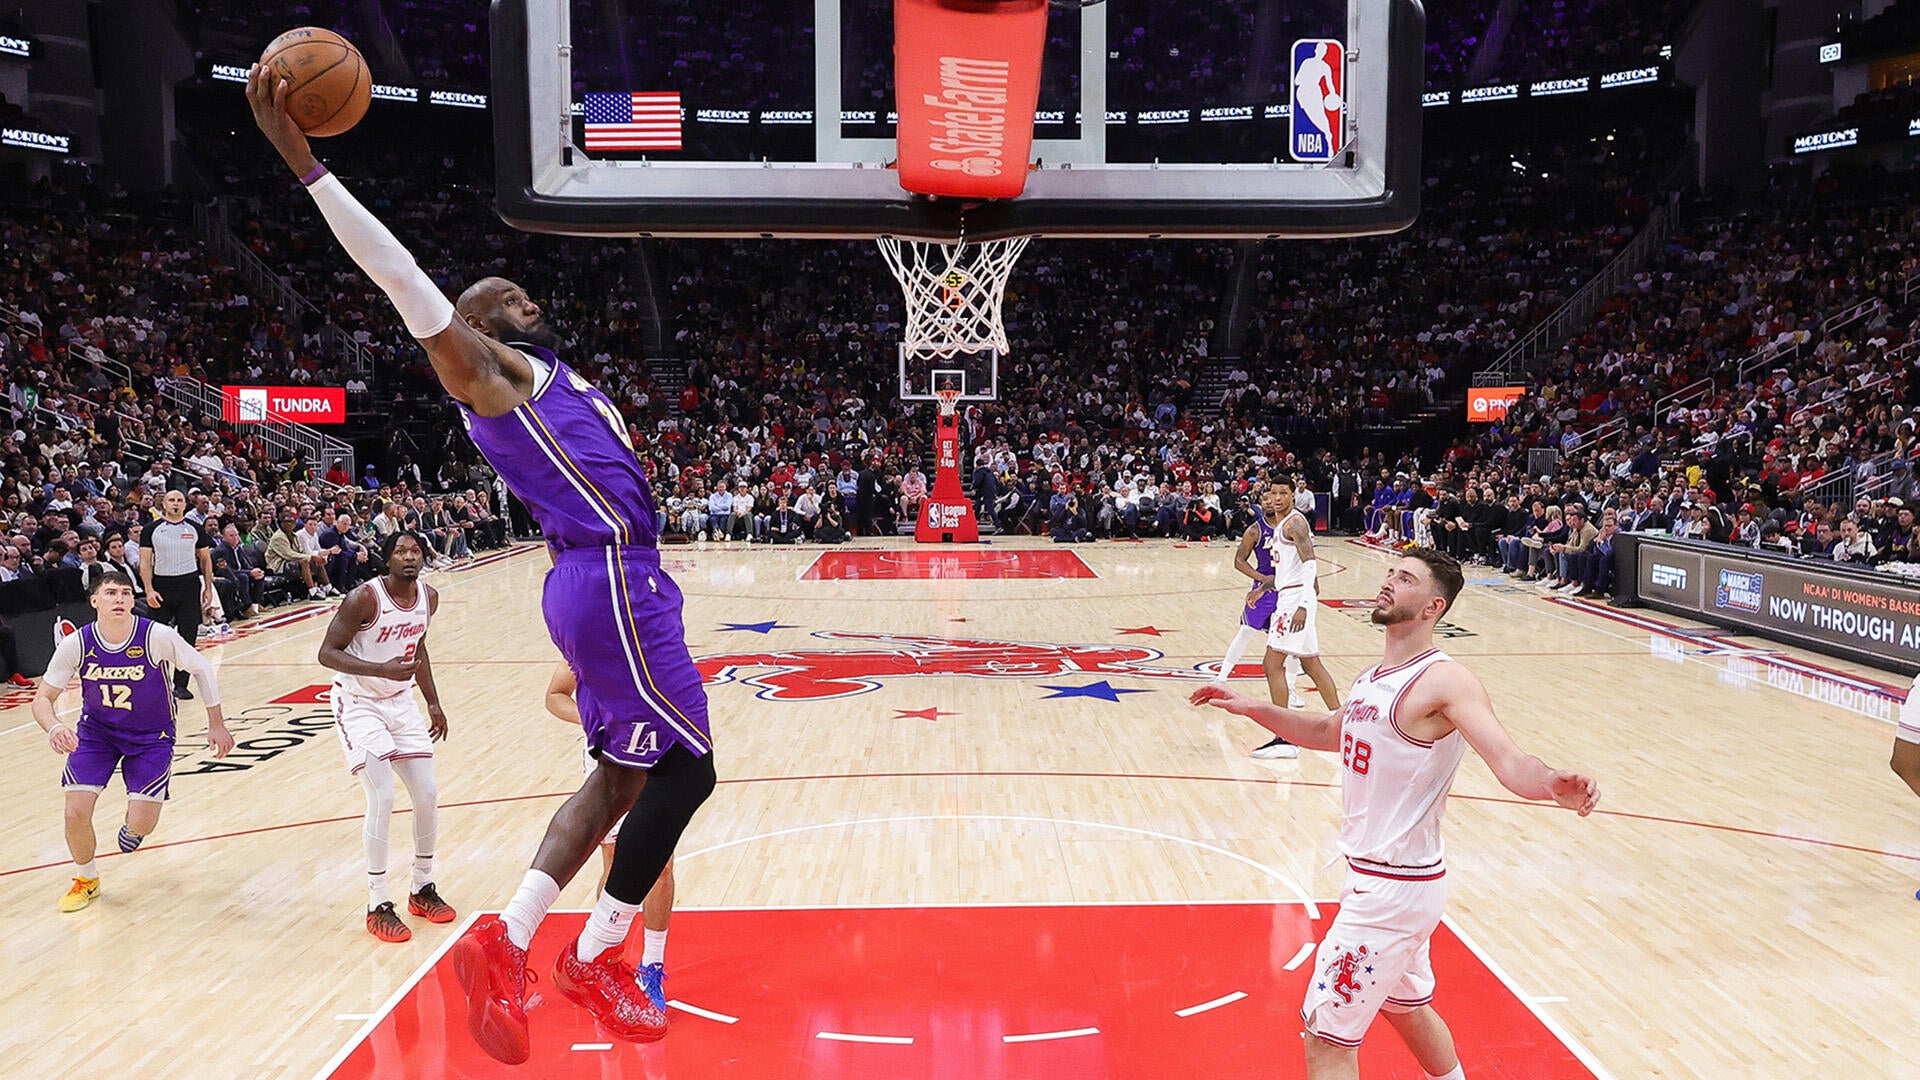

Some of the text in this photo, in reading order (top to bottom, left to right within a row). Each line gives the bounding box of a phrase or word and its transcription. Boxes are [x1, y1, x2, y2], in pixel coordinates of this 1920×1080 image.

[0, 36, 30, 51] ON'S
[1601, 66, 1658, 84] MORTON'S
[371, 84, 418, 98] ORTON'S
[1461, 84, 1519, 99] MORTON'S
[1530, 77, 1590, 92] MORTON'S
[429, 90, 487, 105] MORTON'S
[1422, 91, 1450, 102] ON'S
[696, 109, 750, 119] MORTON'S
[759, 110, 813, 120] MORTON'S
[840, 111, 876, 120] RTON'S
[1034, 111, 1064, 120] TON'S
[1138, 109, 1191, 120] MORTON'S
[1200, 106, 1254, 117] MORTON'S
[2, 128, 69, 147] MORTON'S
[1298, 133, 1322, 153] NBA
[1794, 128, 1859, 148] MORTON'S
[272, 398, 332, 413] TUNDRA
[941, 503, 967, 517] League
[941, 516, 959, 528] Pass
[1651, 563, 1687, 591] ESPN
[1727, 572, 1750, 591] MARCH
[1728, 588, 1761, 608] MADNESS
[1843, 590, 1888, 610] WOMEN'S
[1769, 595, 1808, 624] NOW
[1811, 604, 1896, 644] THROUGH
[376, 622, 425, 644] H-Town
[82, 662, 145, 681] LAKERS
[99, 684, 132, 711] 12
[622, 721, 660, 757] LA
[1343, 732, 1372, 776] 28
